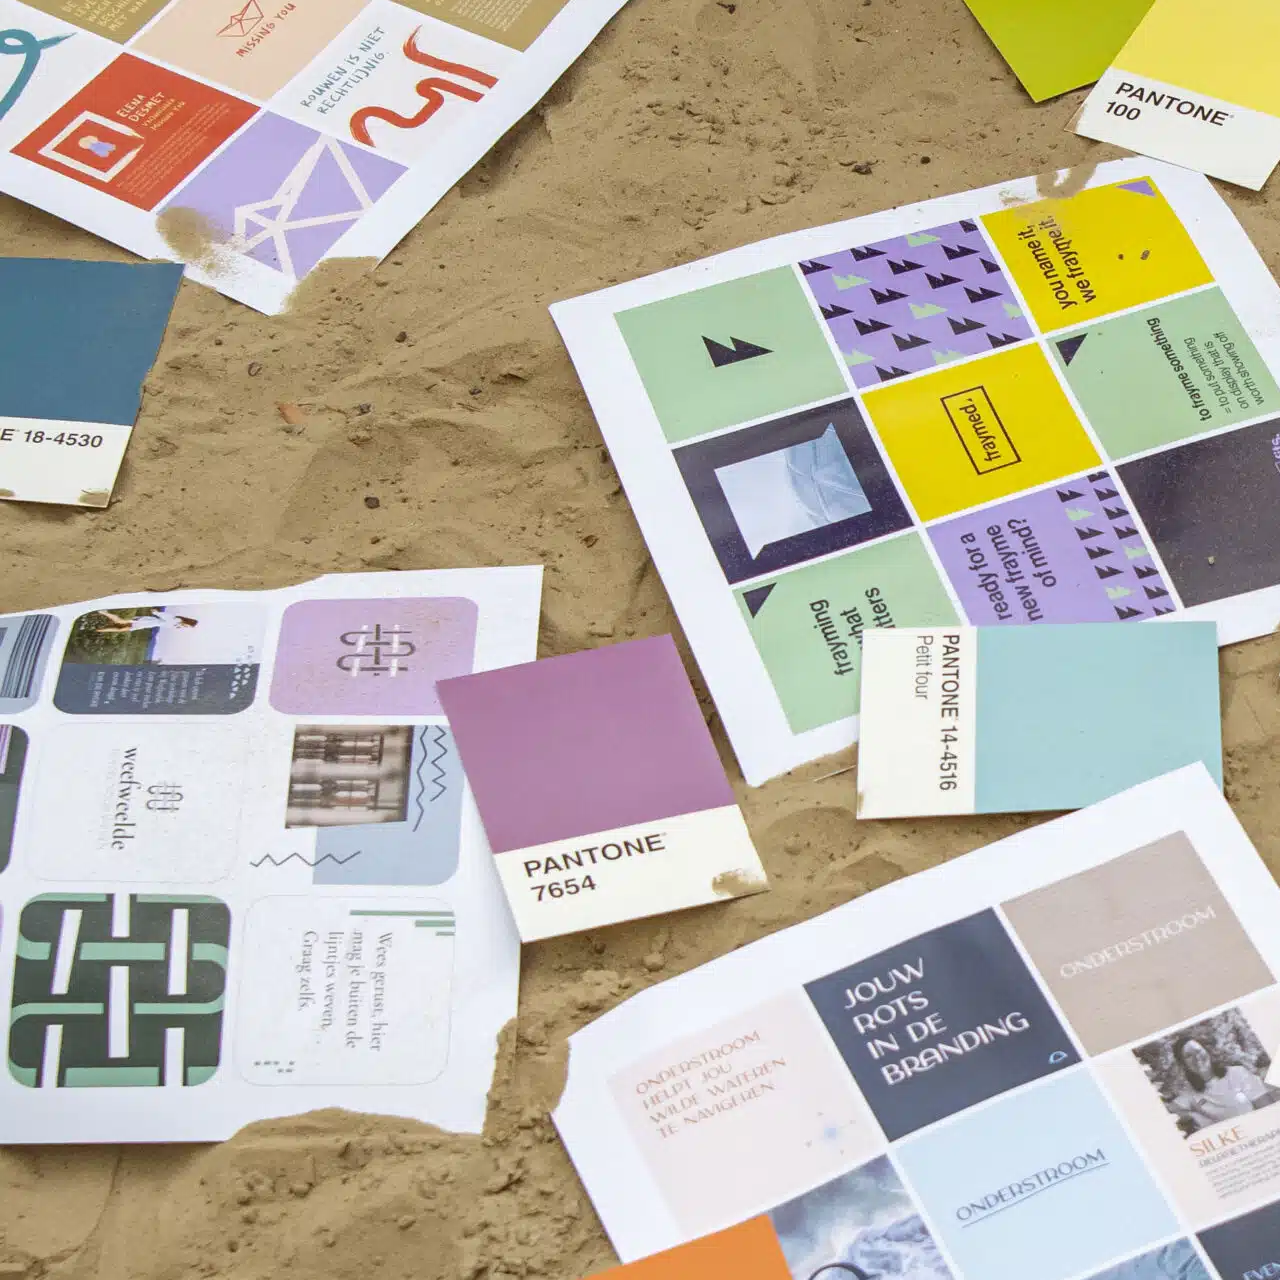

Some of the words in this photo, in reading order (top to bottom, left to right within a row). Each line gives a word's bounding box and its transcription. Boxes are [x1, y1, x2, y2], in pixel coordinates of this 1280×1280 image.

[235, 22, 276, 57] MISSING
[274, 2, 297, 21] YOU
[300, 65, 348, 108] ROUWEN
[358, 26, 385, 53] NIET
[115, 93, 146, 118] ELENA
[128, 91, 165, 122] DESMET
[1106, 101, 1141, 121] 100
[1115, 81, 1229, 126] PANTONE
[1027, 240, 1059, 279] name
[1049, 229, 1085, 279] frayme
[1049, 279, 1078, 310] you
[1076, 279, 1096, 303] we
[1146, 317, 1184, 373] something
[1183, 337, 1215, 382] something
[1207, 349, 1225, 367] that
[1223, 341, 1250, 379] showing
[1178, 372, 1205, 409] frayme
[1208, 381, 1225, 396] put
[1220, 366, 1242, 396] display
[1243, 377, 1265, 406] worth
[1199, 408, 1212, 421] to
[1219, 395, 1230, 407] to
[1236, 393, 1249, 409] on
[23, 429, 104, 448] 18-4530
[960, 532, 976, 544] a
[986, 525, 1024, 583] frayme
[1007, 518, 1048, 568] mind?
[965, 547, 988, 571] for
[977, 573, 1012, 620] ready
[1032, 570, 1057, 588] of
[865, 587, 896, 629] tters
[1015, 585, 1044, 621] new
[809, 598, 854, 676] frayming
[915, 635, 934, 671] Petit
[915, 671, 933, 700] four
[941, 634, 960, 718] PANTONE
[939, 725, 958, 791] 14-4516
[111, 747, 141, 850] weefweelde
[523, 833, 666, 878] PANTONE
[530, 875, 597, 902] 7654
[295, 929, 319, 974] Graag
[321, 931, 345, 978] lijntjes
[345, 930, 363, 961] mag
[376, 932, 393, 968] Wees
[1059, 905, 1217, 978] ONDERSTROOM
[347, 965, 366, 976] je
[844, 957, 924, 1010] JOUW
[346, 981, 367, 1026] buiten
[853, 990, 929, 1035] ROTS
[345, 1030, 364, 1049] de
[370, 1022, 389, 1052] hier
[866, 1032, 900, 1060] IN
[905, 1012, 948, 1043] DE
[880, 1011, 1031, 1086] BRANDING
[635, 1030, 761, 1096] ONDERSTROOM
[642, 1078, 693, 1110] HELPT
[701, 1063, 732, 1084] JOU
[650, 1093, 700, 1124] WILDE
[707, 1057, 787, 1096] WATEREN
[656, 1124, 678, 1139] TE
[683, 1080, 775, 1124] NAVIGEREN
[1190, 1124, 1248, 1157] SILKE
[956, 1148, 1107, 1221] ONDERSTROOM
